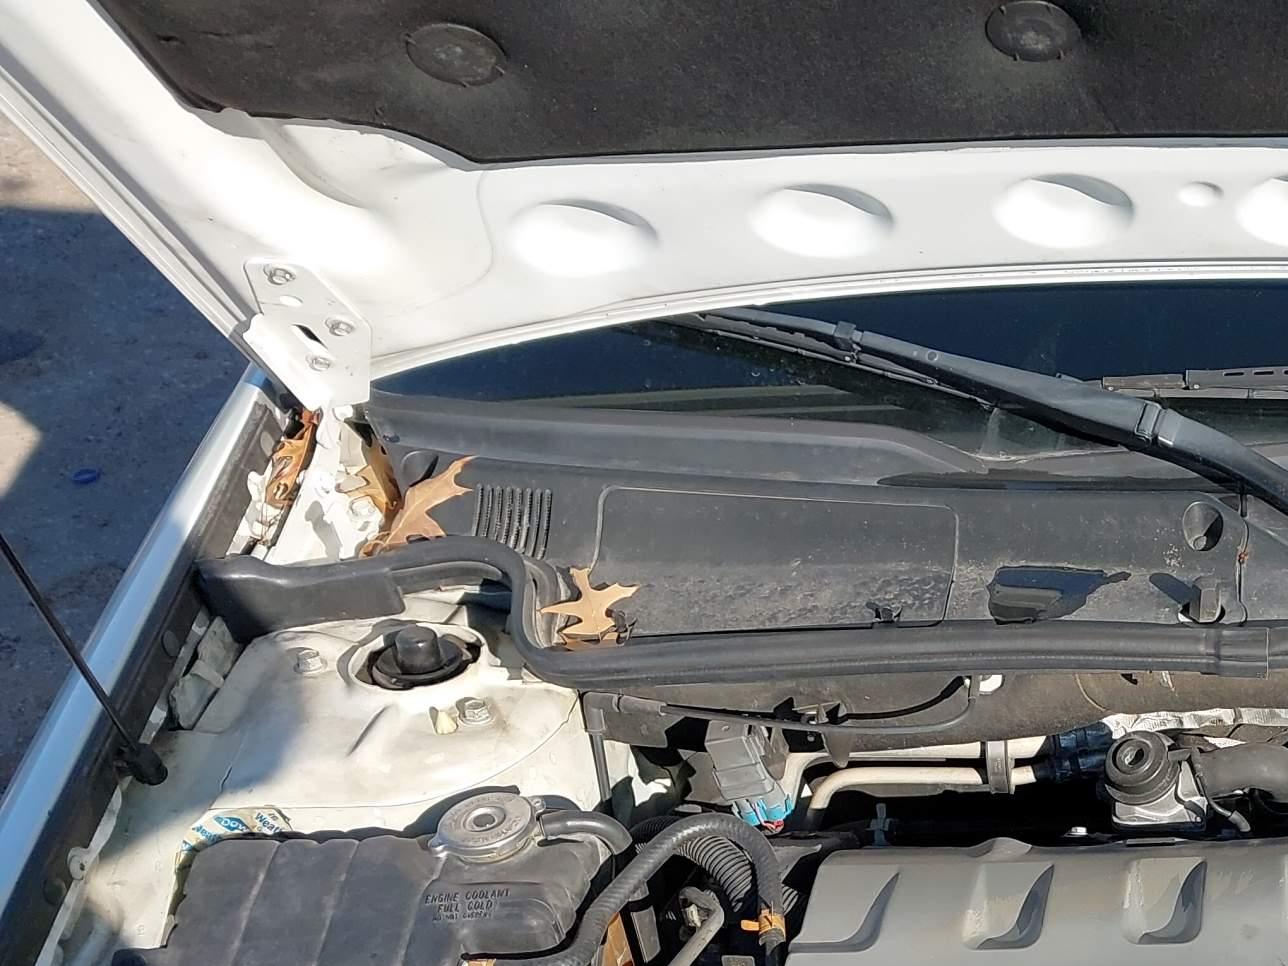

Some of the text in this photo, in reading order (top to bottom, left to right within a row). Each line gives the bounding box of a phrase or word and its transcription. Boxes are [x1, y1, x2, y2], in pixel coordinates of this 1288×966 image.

[425, 888, 510, 904] ENGINE COOLANT
[438, 900, 493, 912] FULL COLD
